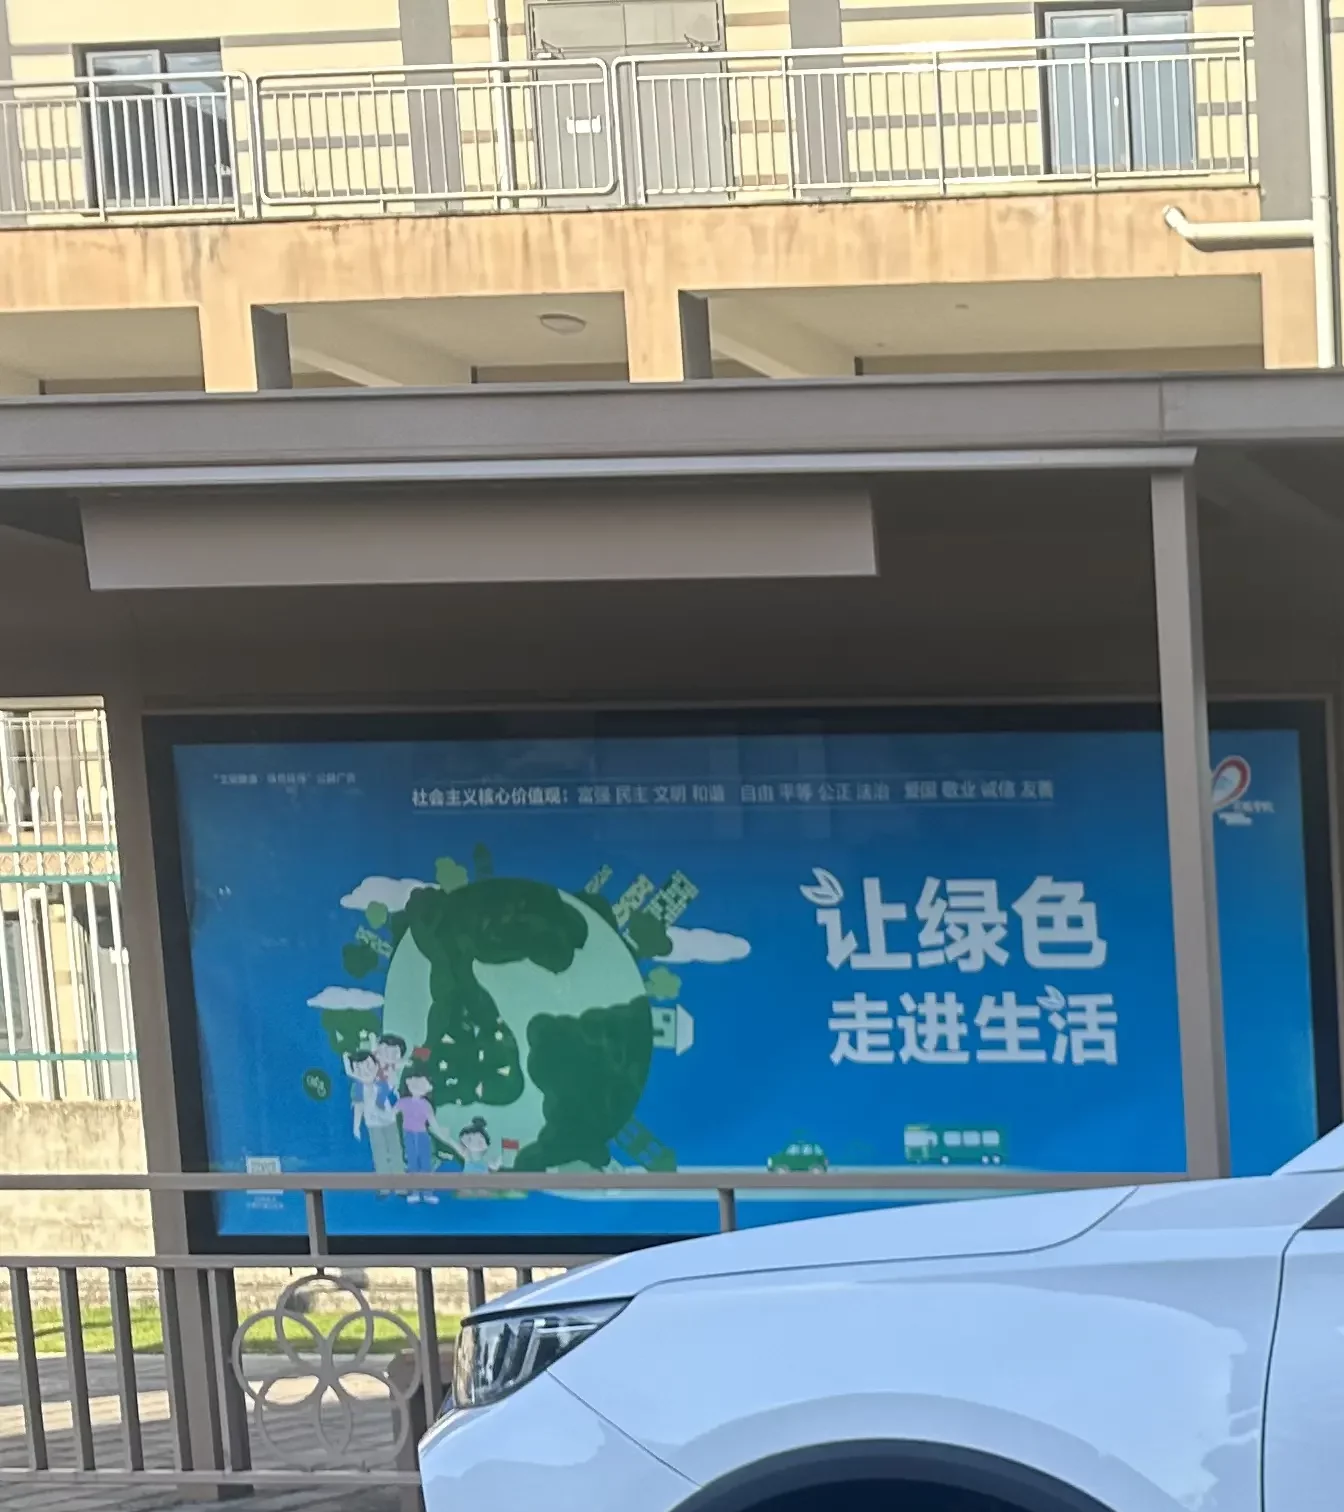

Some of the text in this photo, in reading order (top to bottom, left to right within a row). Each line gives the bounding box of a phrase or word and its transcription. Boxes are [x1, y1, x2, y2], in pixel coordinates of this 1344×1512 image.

[799, 867, 1107, 973] 让绿色
[827, 984, 1118, 1066] 走进生活
